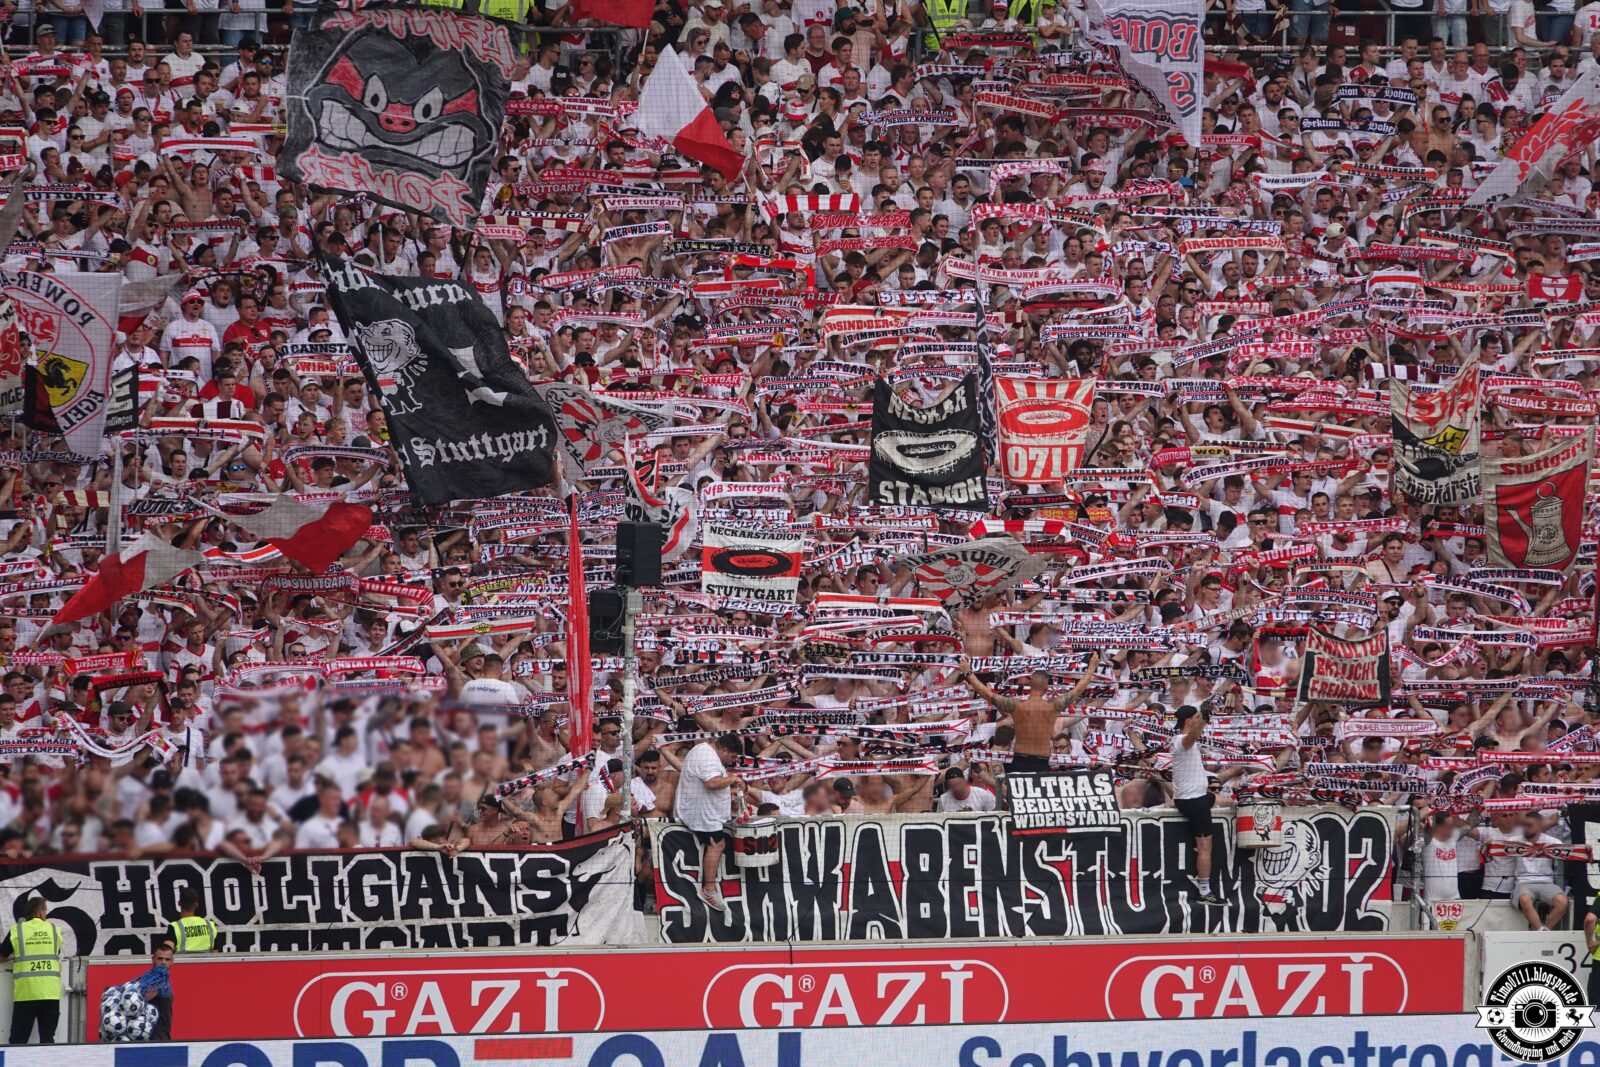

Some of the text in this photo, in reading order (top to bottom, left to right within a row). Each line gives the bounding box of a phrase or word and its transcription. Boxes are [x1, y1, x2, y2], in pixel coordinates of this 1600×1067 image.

[948, 260, 1008, 277] CANNSATTER
[1497, 395, 1548, 410] NIEMALS
[1564, 403, 1597, 413] LIGA!
[411, 424, 549, 468] Stuttgart
[1501, 437, 1588, 476] Stuttgart
[705, 484, 783, 496] VfB Stuttgart
[879, 476, 985, 506] STADION
[708, 527, 801, 541] NECKARSTADION
[1471, 569, 1530, 579] NNSTATTER
[706, 584, 795, 600] STUTTGART
[695, 626, 771, 638] STUTTGART
[1009, 773, 1113, 798] ULTRAS
[1013, 794, 1115, 814] BEDEUTET
[1013, 811, 1120, 829] WIDERSTAND
[90, 852, 572, 929] HOOLIGANS
[184, 925, 209, 937] SECURITY
[30, 961, 52, 971] 2478
